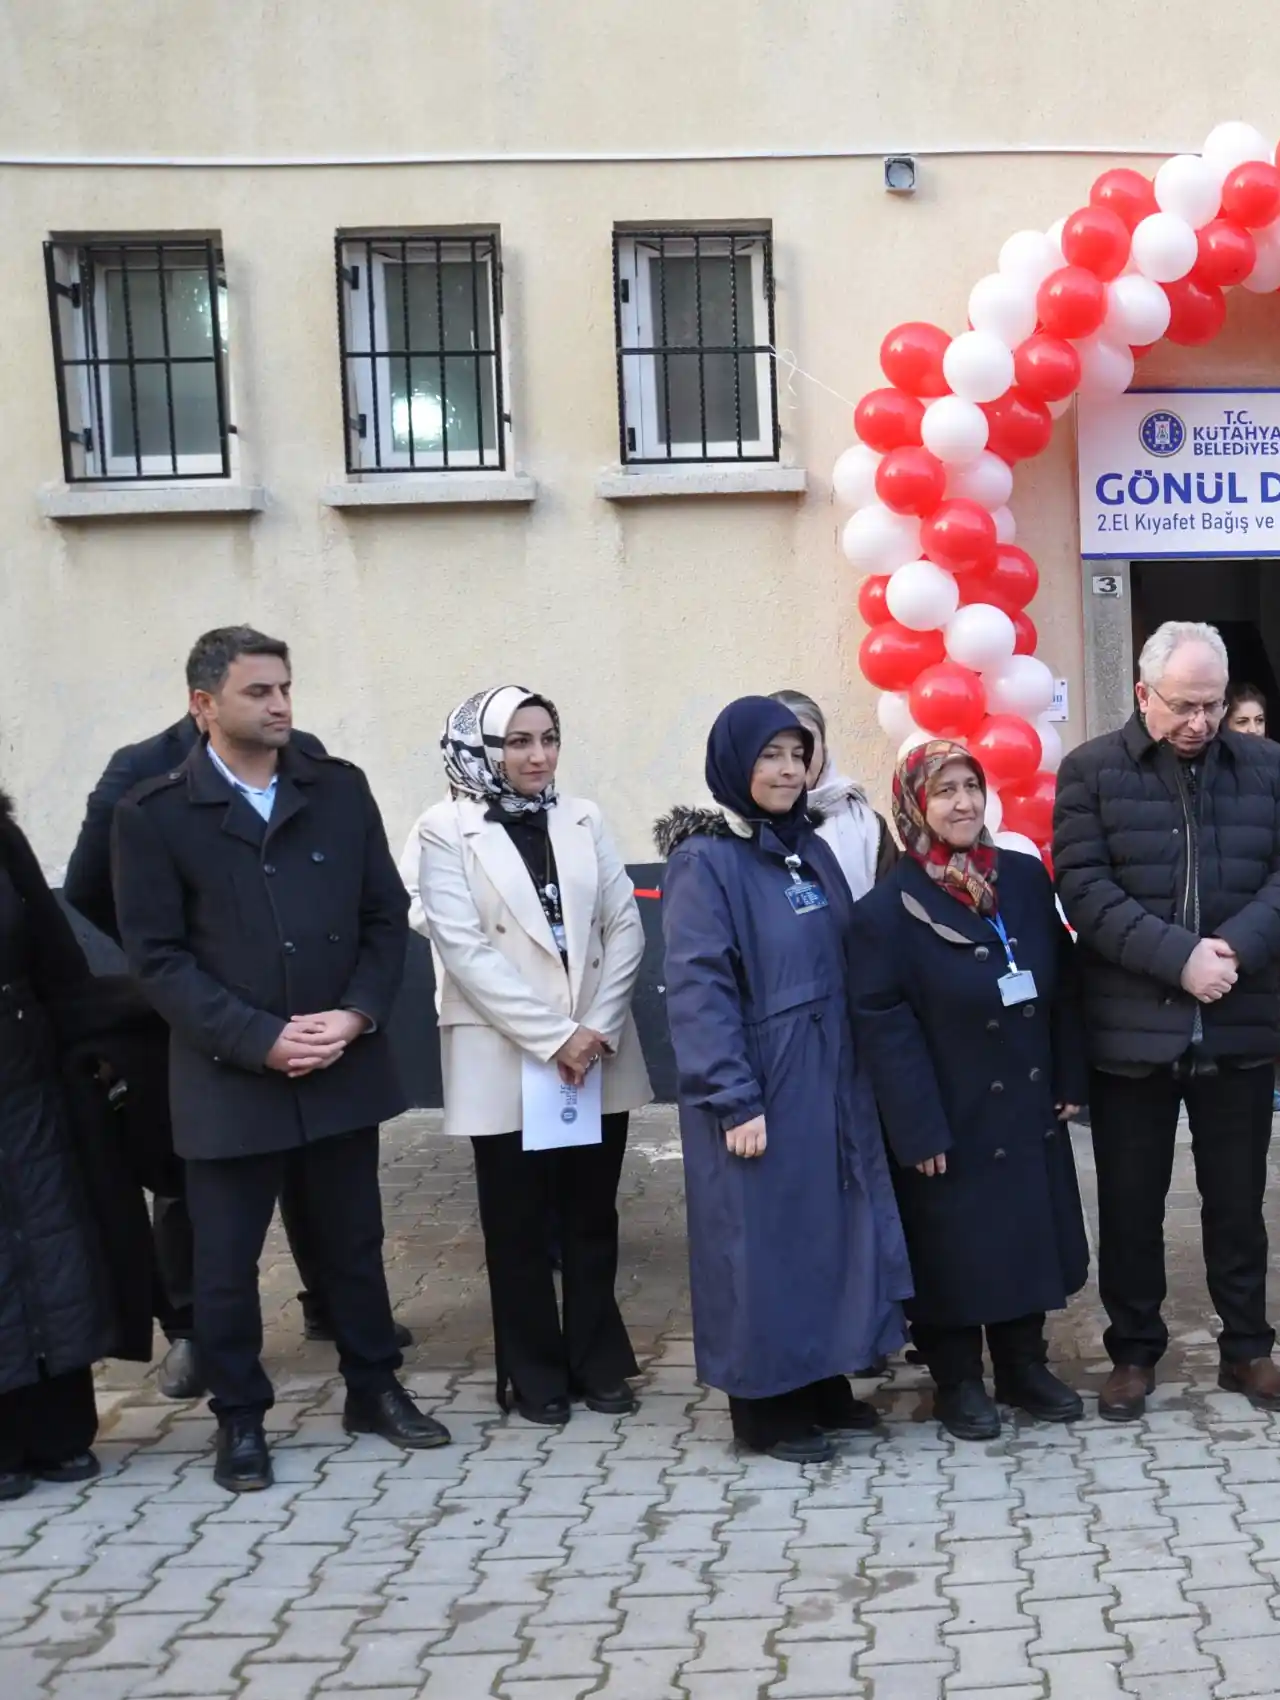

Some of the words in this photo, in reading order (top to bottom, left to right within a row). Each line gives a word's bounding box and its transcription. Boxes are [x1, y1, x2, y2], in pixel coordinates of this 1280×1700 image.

[1223, 410, 1252, 425] T.C.
[1095, 469, 1248, 505] GÖNÜL
[1097, 513, 1129, 532] 2.El
[1135, 512, 1195, 535] Kıyafet
[1201, 511, 1249, 534] Bağış
[1255, 515, 1275, 529] ve
[1099, 577, 1117, 592] 3
